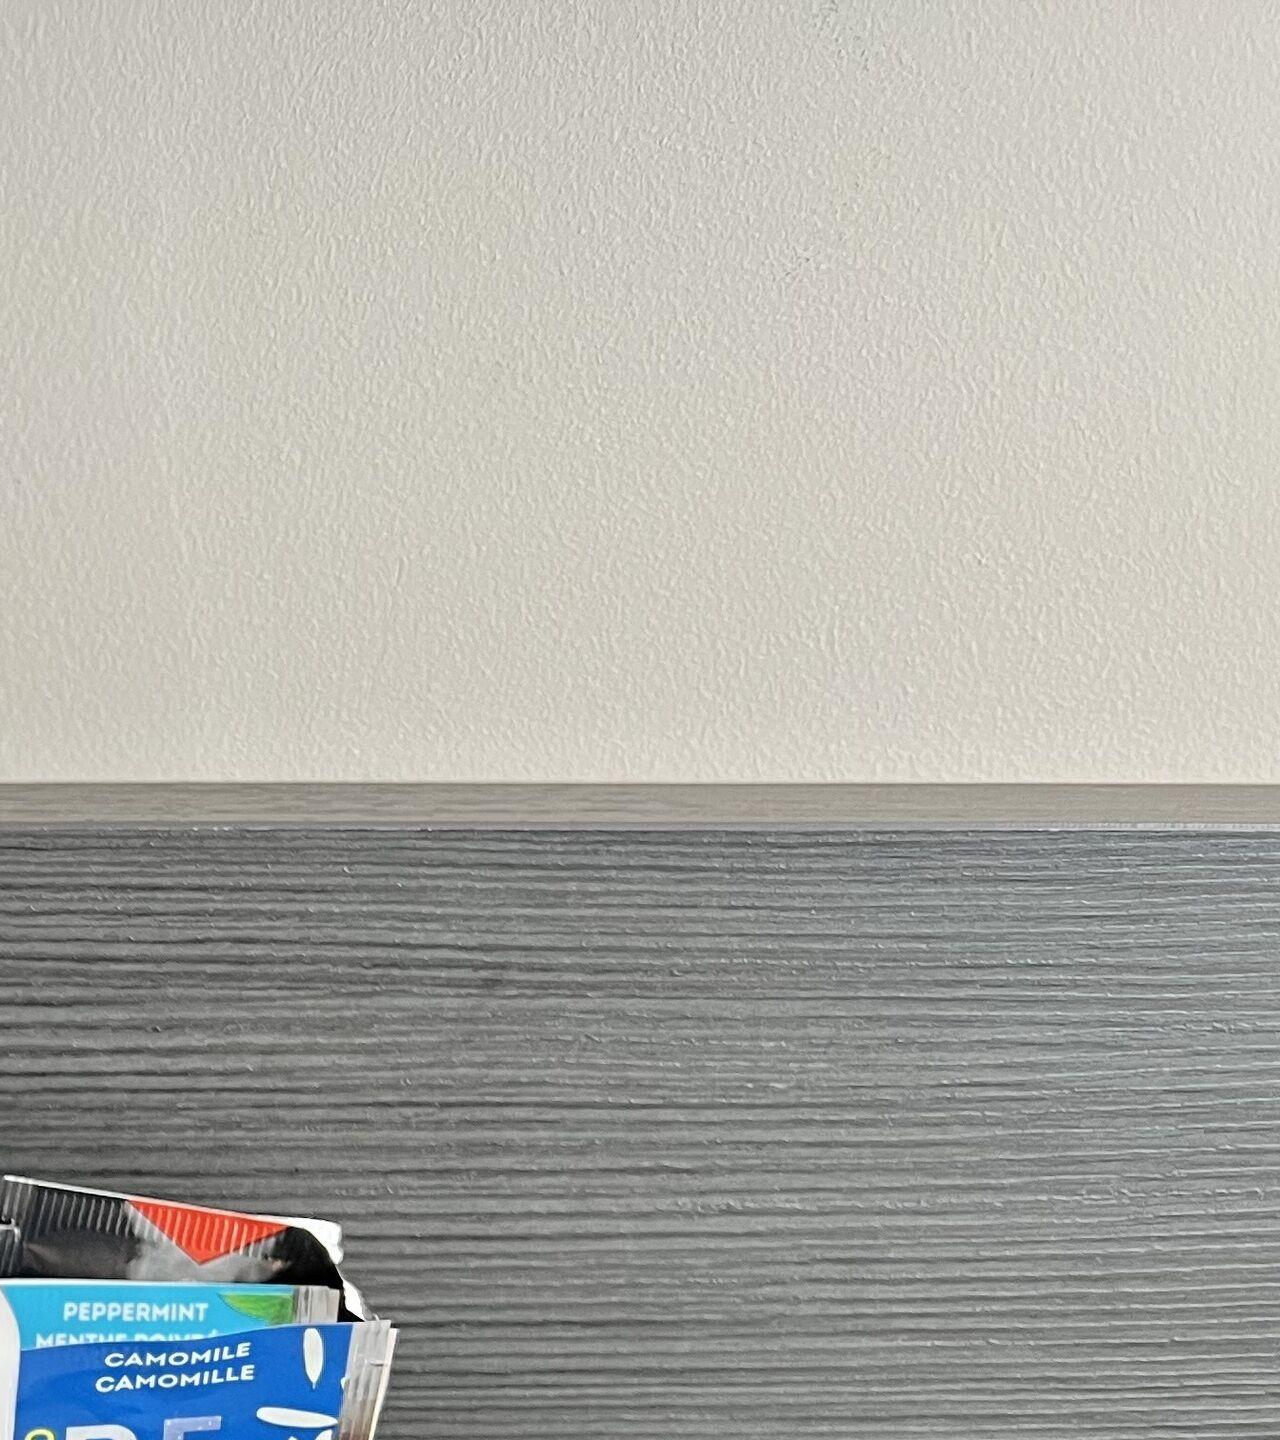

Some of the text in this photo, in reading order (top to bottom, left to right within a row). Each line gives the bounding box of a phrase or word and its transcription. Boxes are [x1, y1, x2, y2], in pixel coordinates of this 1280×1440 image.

[63, 1302, 209, 1323] PEPPERMINT
[104, 1342, 252, 1368] CAMOMILE
[95, 1364, 255, 1393] CAMOMILLE
